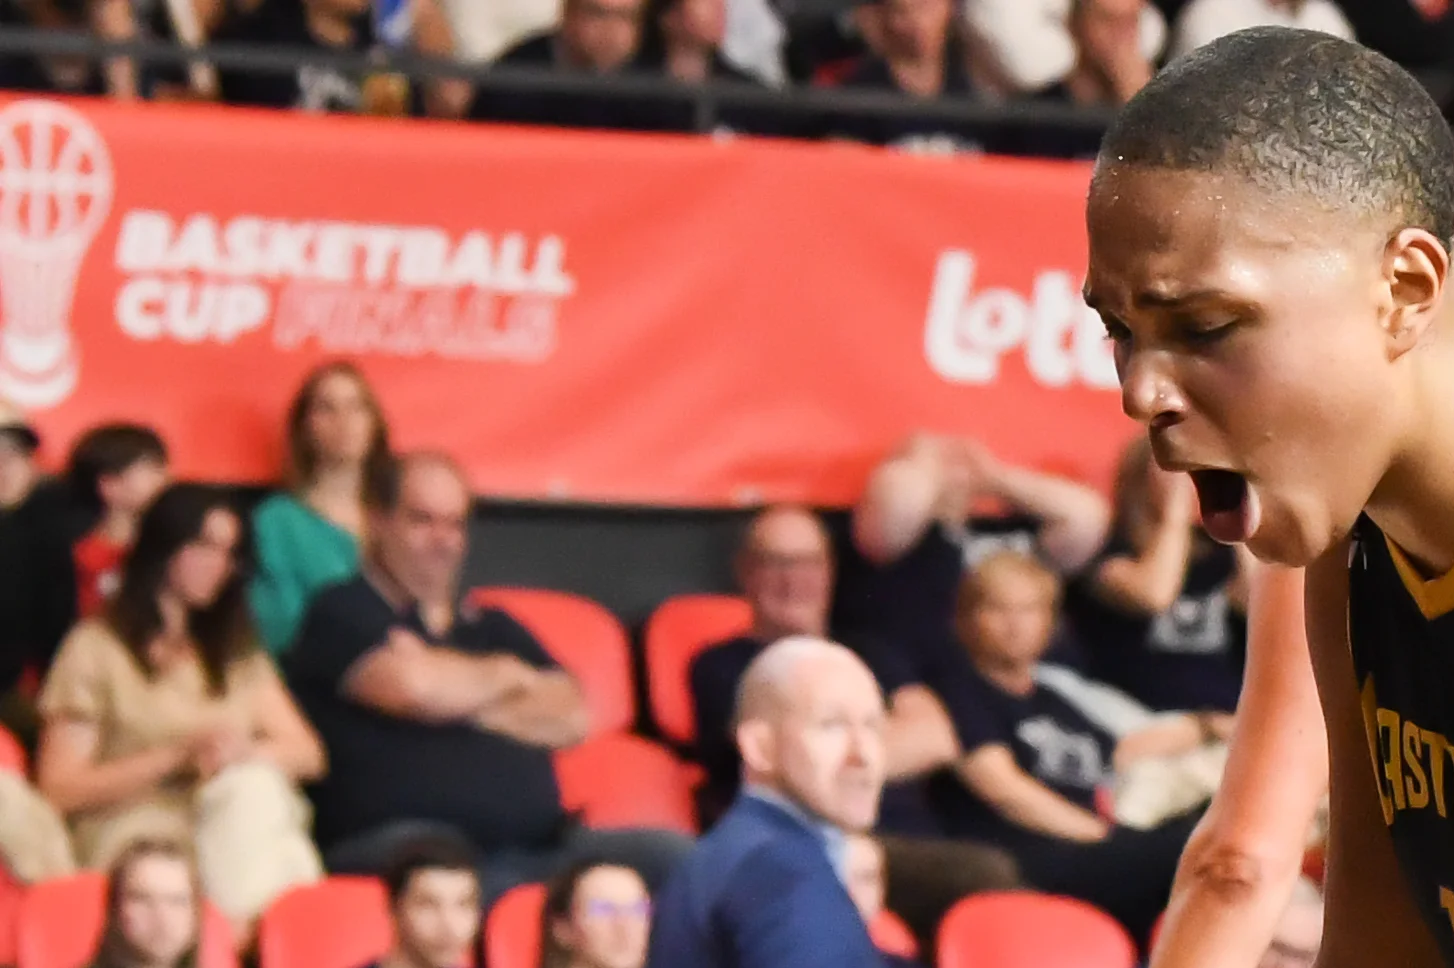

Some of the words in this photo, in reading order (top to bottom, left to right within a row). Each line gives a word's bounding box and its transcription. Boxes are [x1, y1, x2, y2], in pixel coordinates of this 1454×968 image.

[116, 209, 574, 296] BASKETBALL
[115, 276, 269, 343] CUP
[924, 248, 1122, 391] Lott
